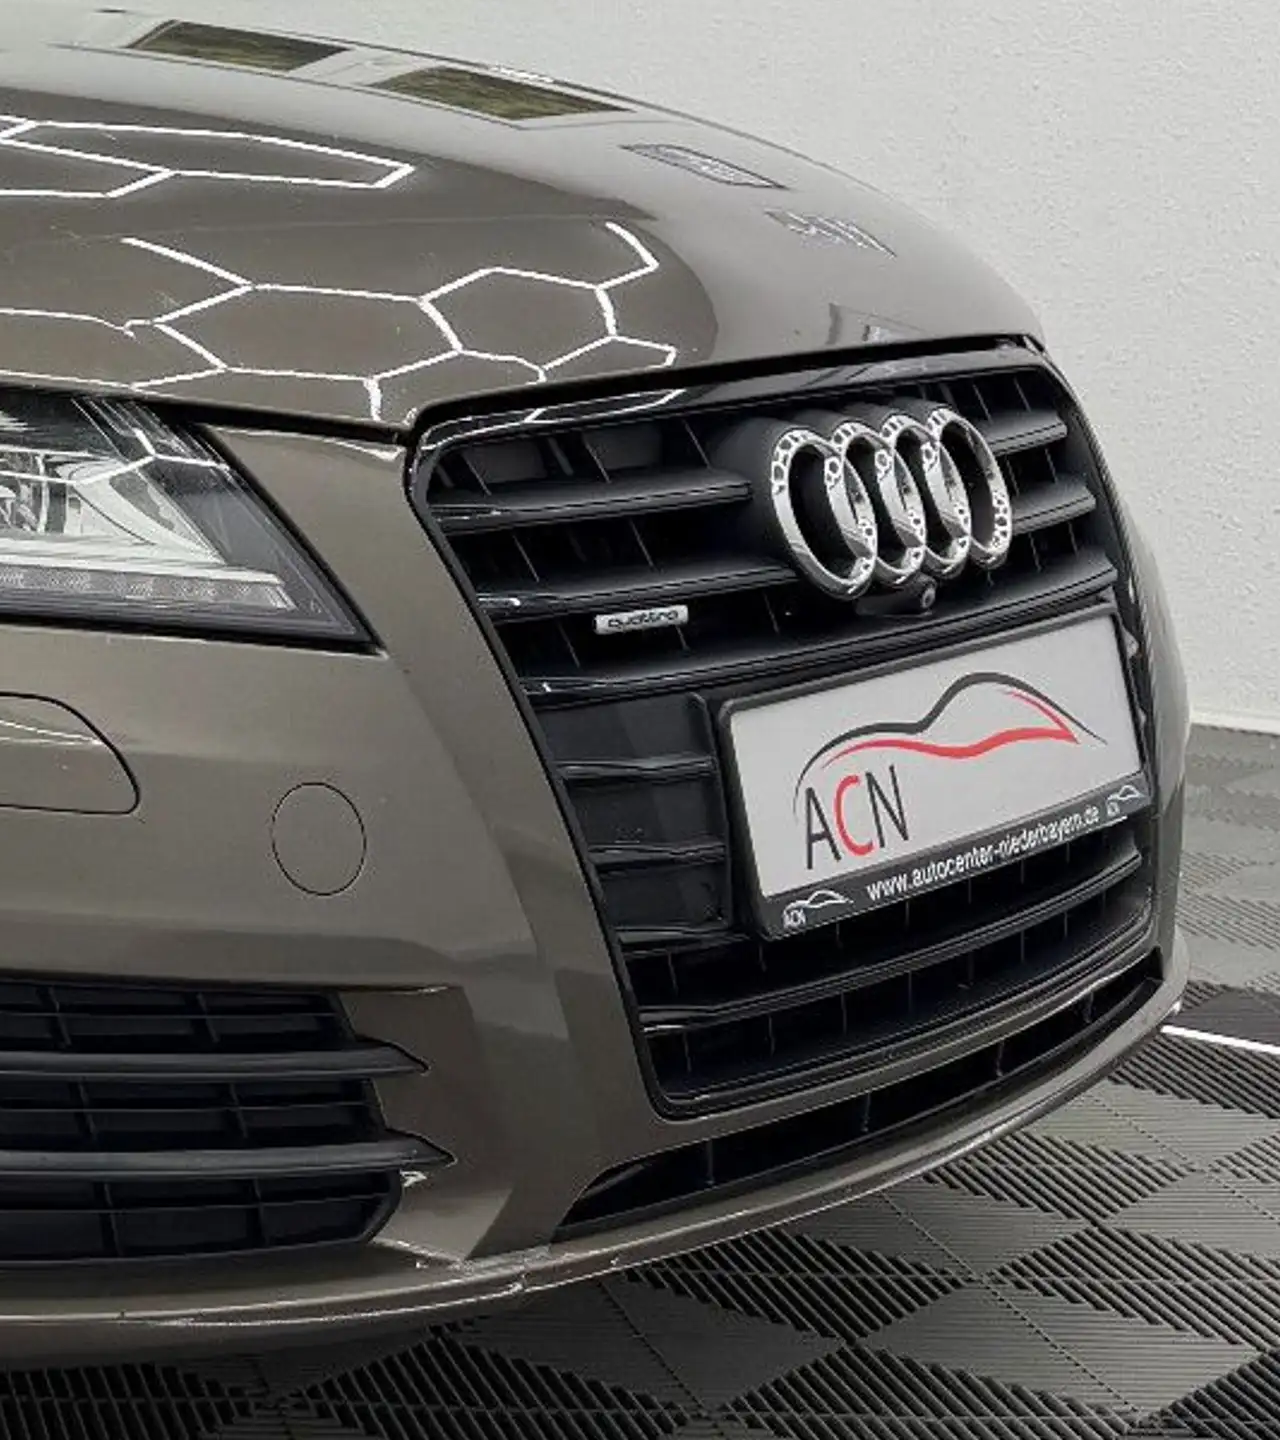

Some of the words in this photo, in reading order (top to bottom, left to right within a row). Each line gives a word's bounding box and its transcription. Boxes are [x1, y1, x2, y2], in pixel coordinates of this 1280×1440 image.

[608, 610, 679, 629] quattro
[805, 764, 909, 870] ACN
[866, 805, 1099, 901] www.autocenter-niederbayern.de
